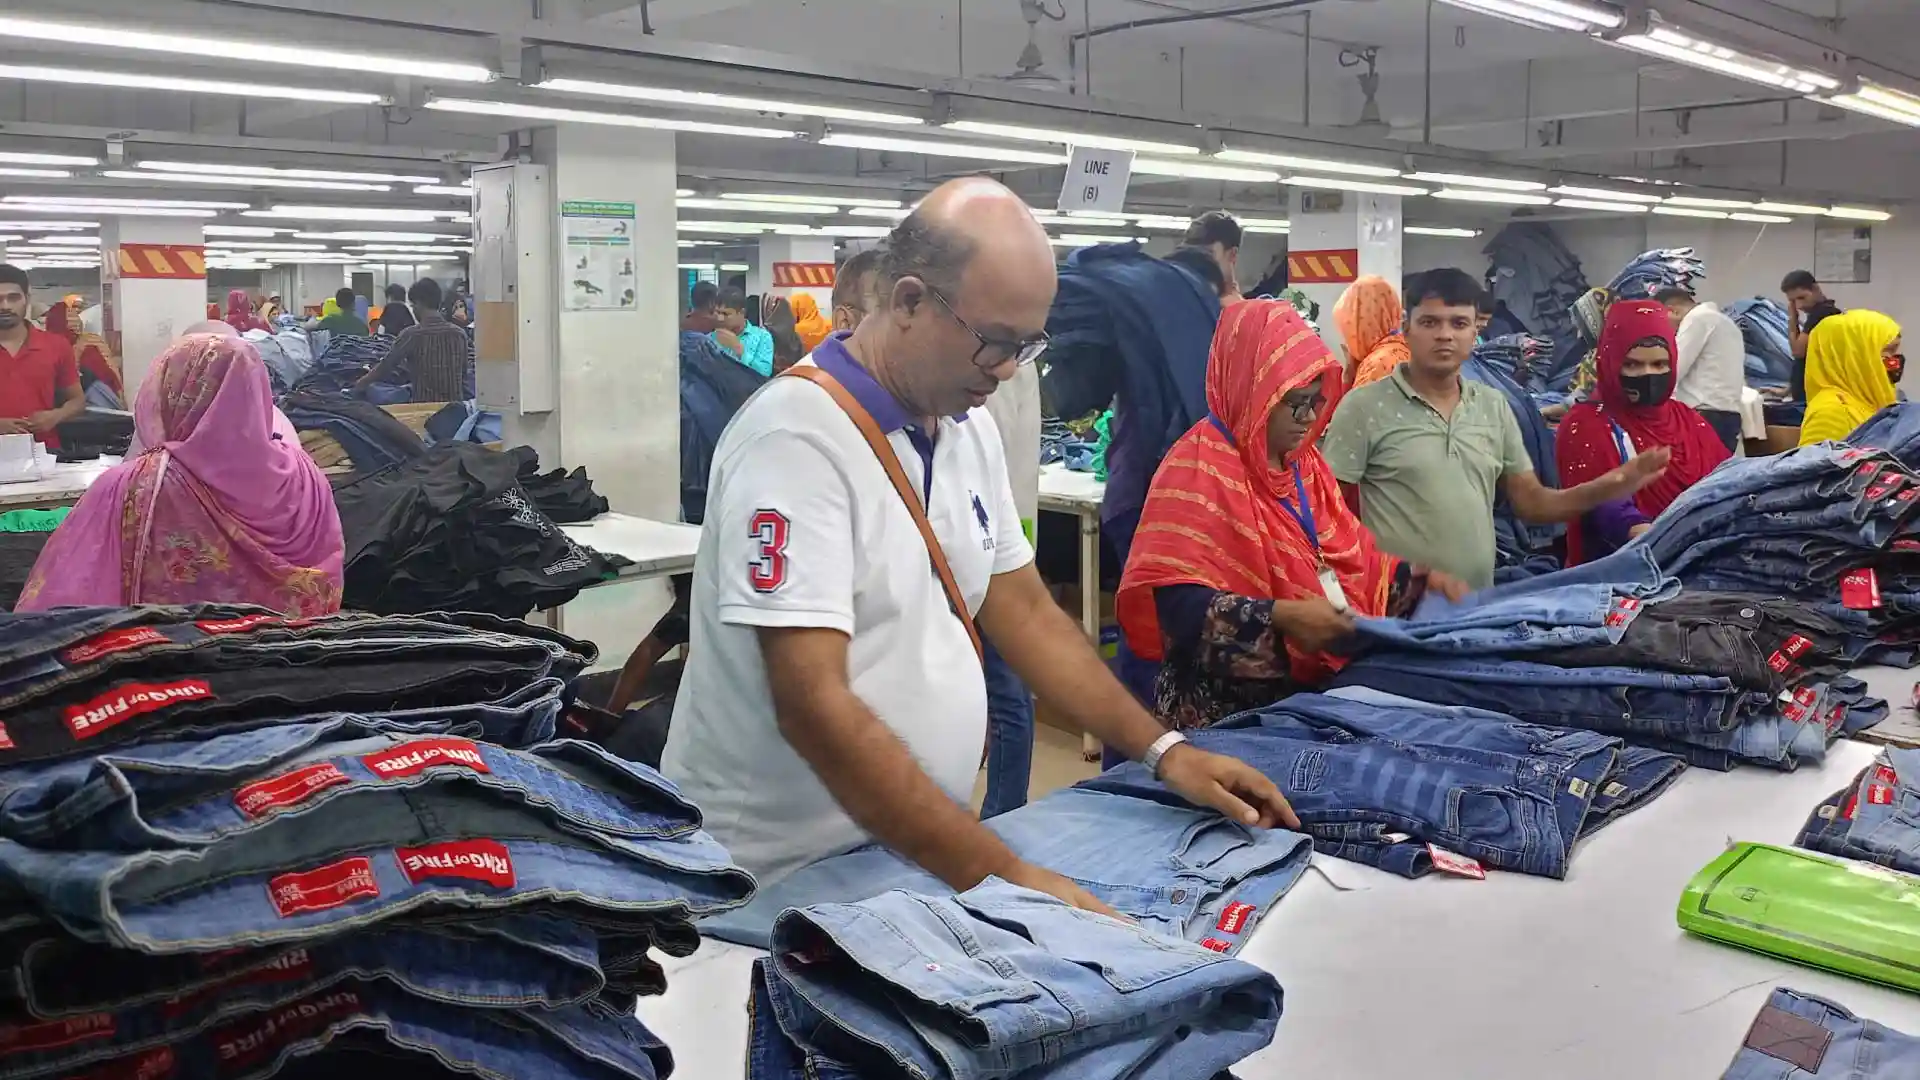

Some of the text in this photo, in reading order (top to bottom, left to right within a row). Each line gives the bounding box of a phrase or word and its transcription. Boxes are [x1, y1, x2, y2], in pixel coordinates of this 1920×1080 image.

[1084, 160, 1110, 175] LINE
[748, 508, 790, 593] 3
[72, 697, 130, 730] FIRE
[374, 751, 425, 773] FIRE
[404, 852, 456, 871] FIRE
[218, 1019, 277, 1060] FIRE
